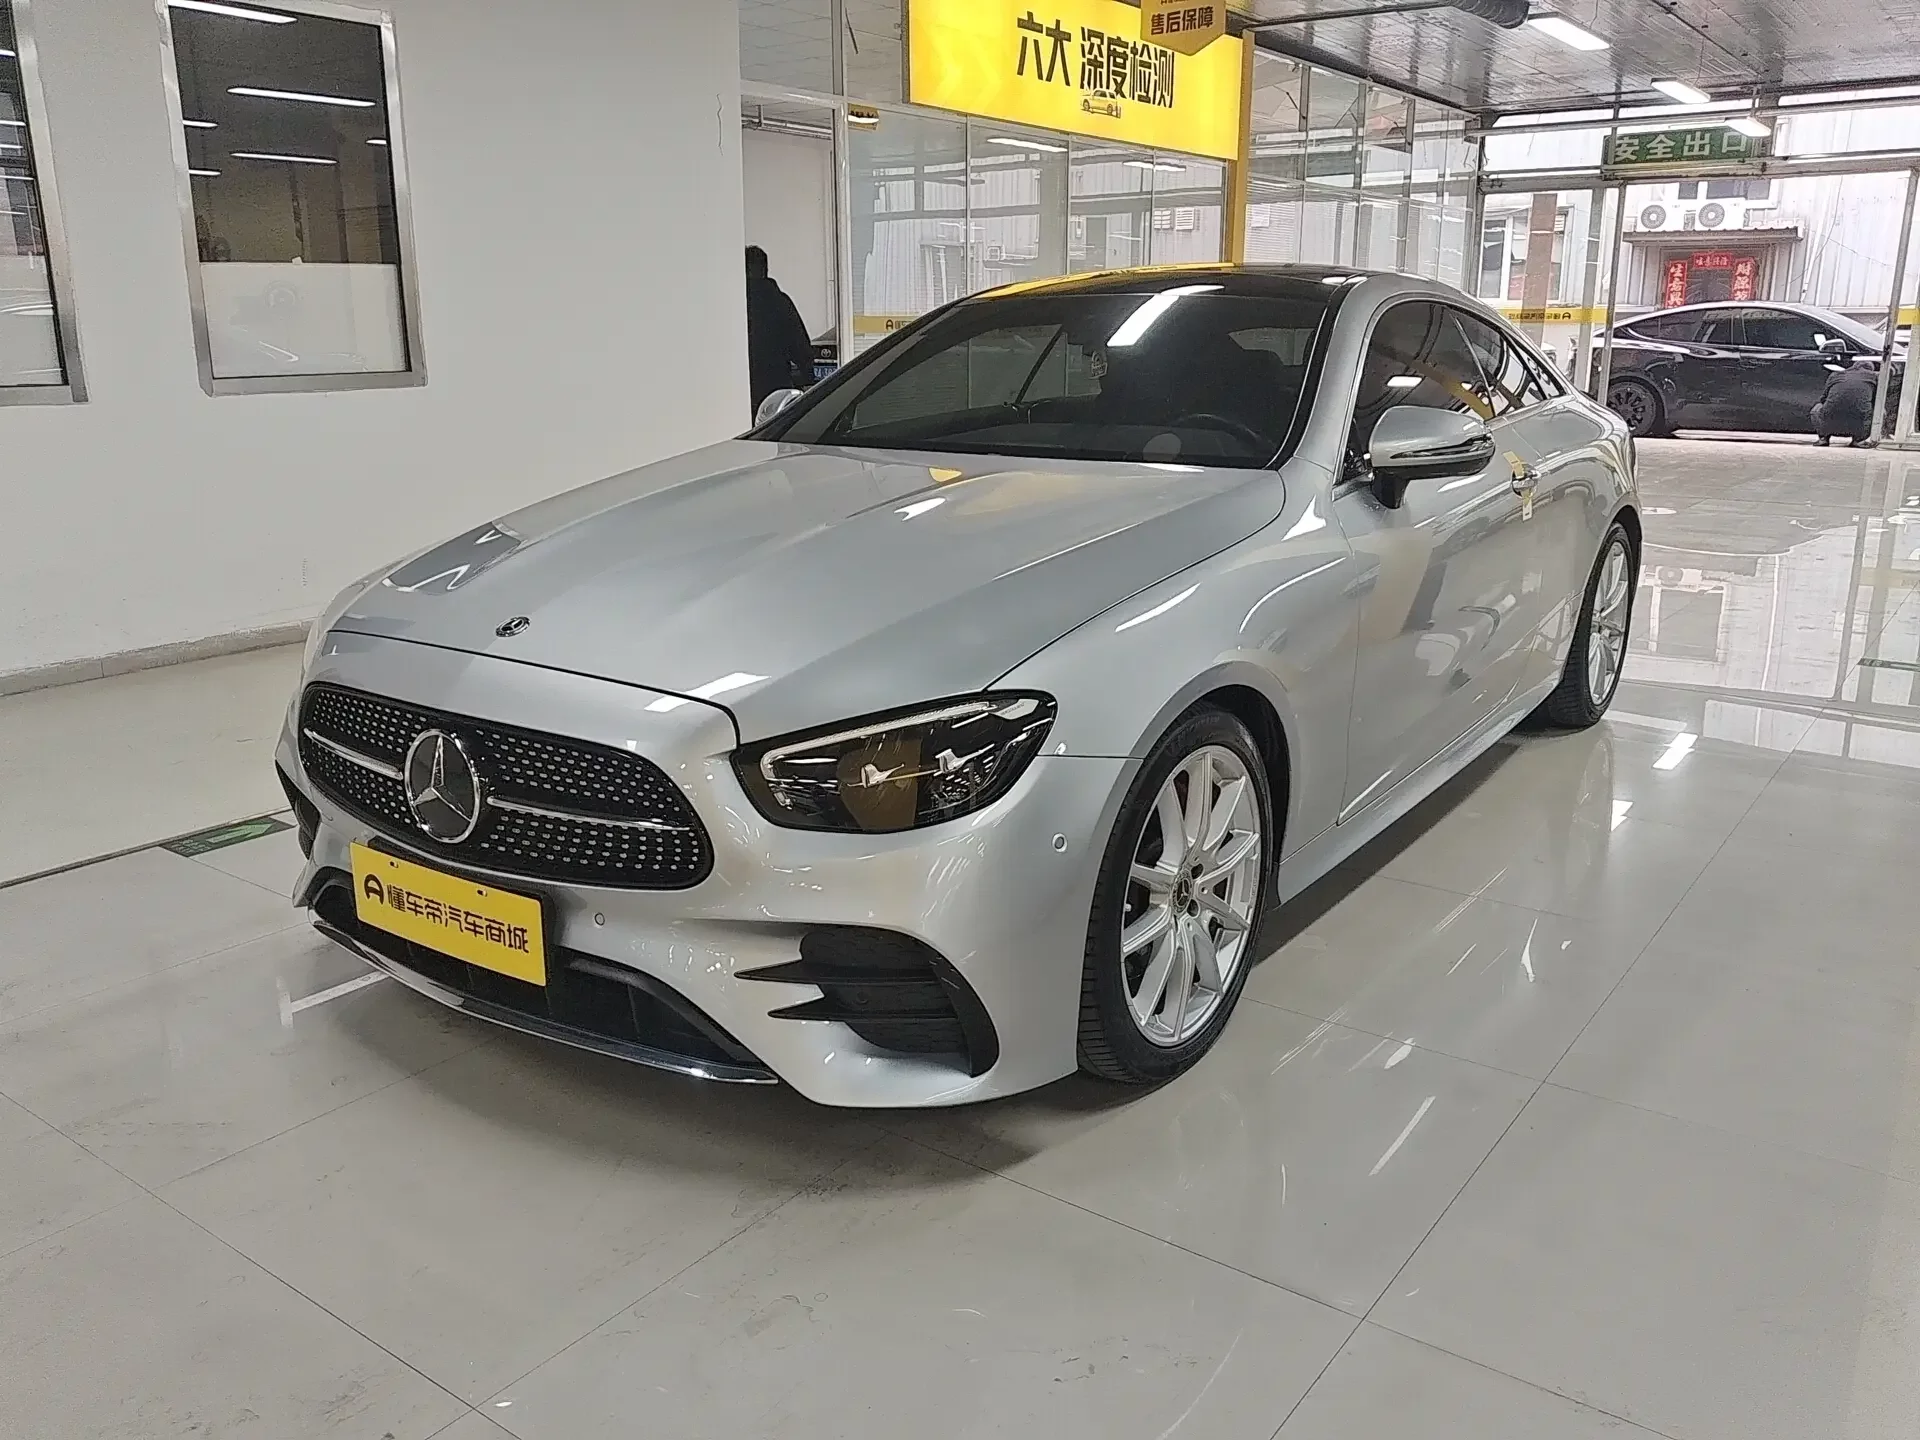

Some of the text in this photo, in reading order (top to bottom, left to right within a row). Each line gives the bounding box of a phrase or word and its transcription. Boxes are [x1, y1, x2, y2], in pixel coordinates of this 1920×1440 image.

[1150, 6, 1214, 36] 售后保障
[1016, 10, 1175, 109] 六大 深度检测
[1614, 130, 1748, 162] 安全出口
[386, 884, 530, 954] 懂车帝汽车商城
